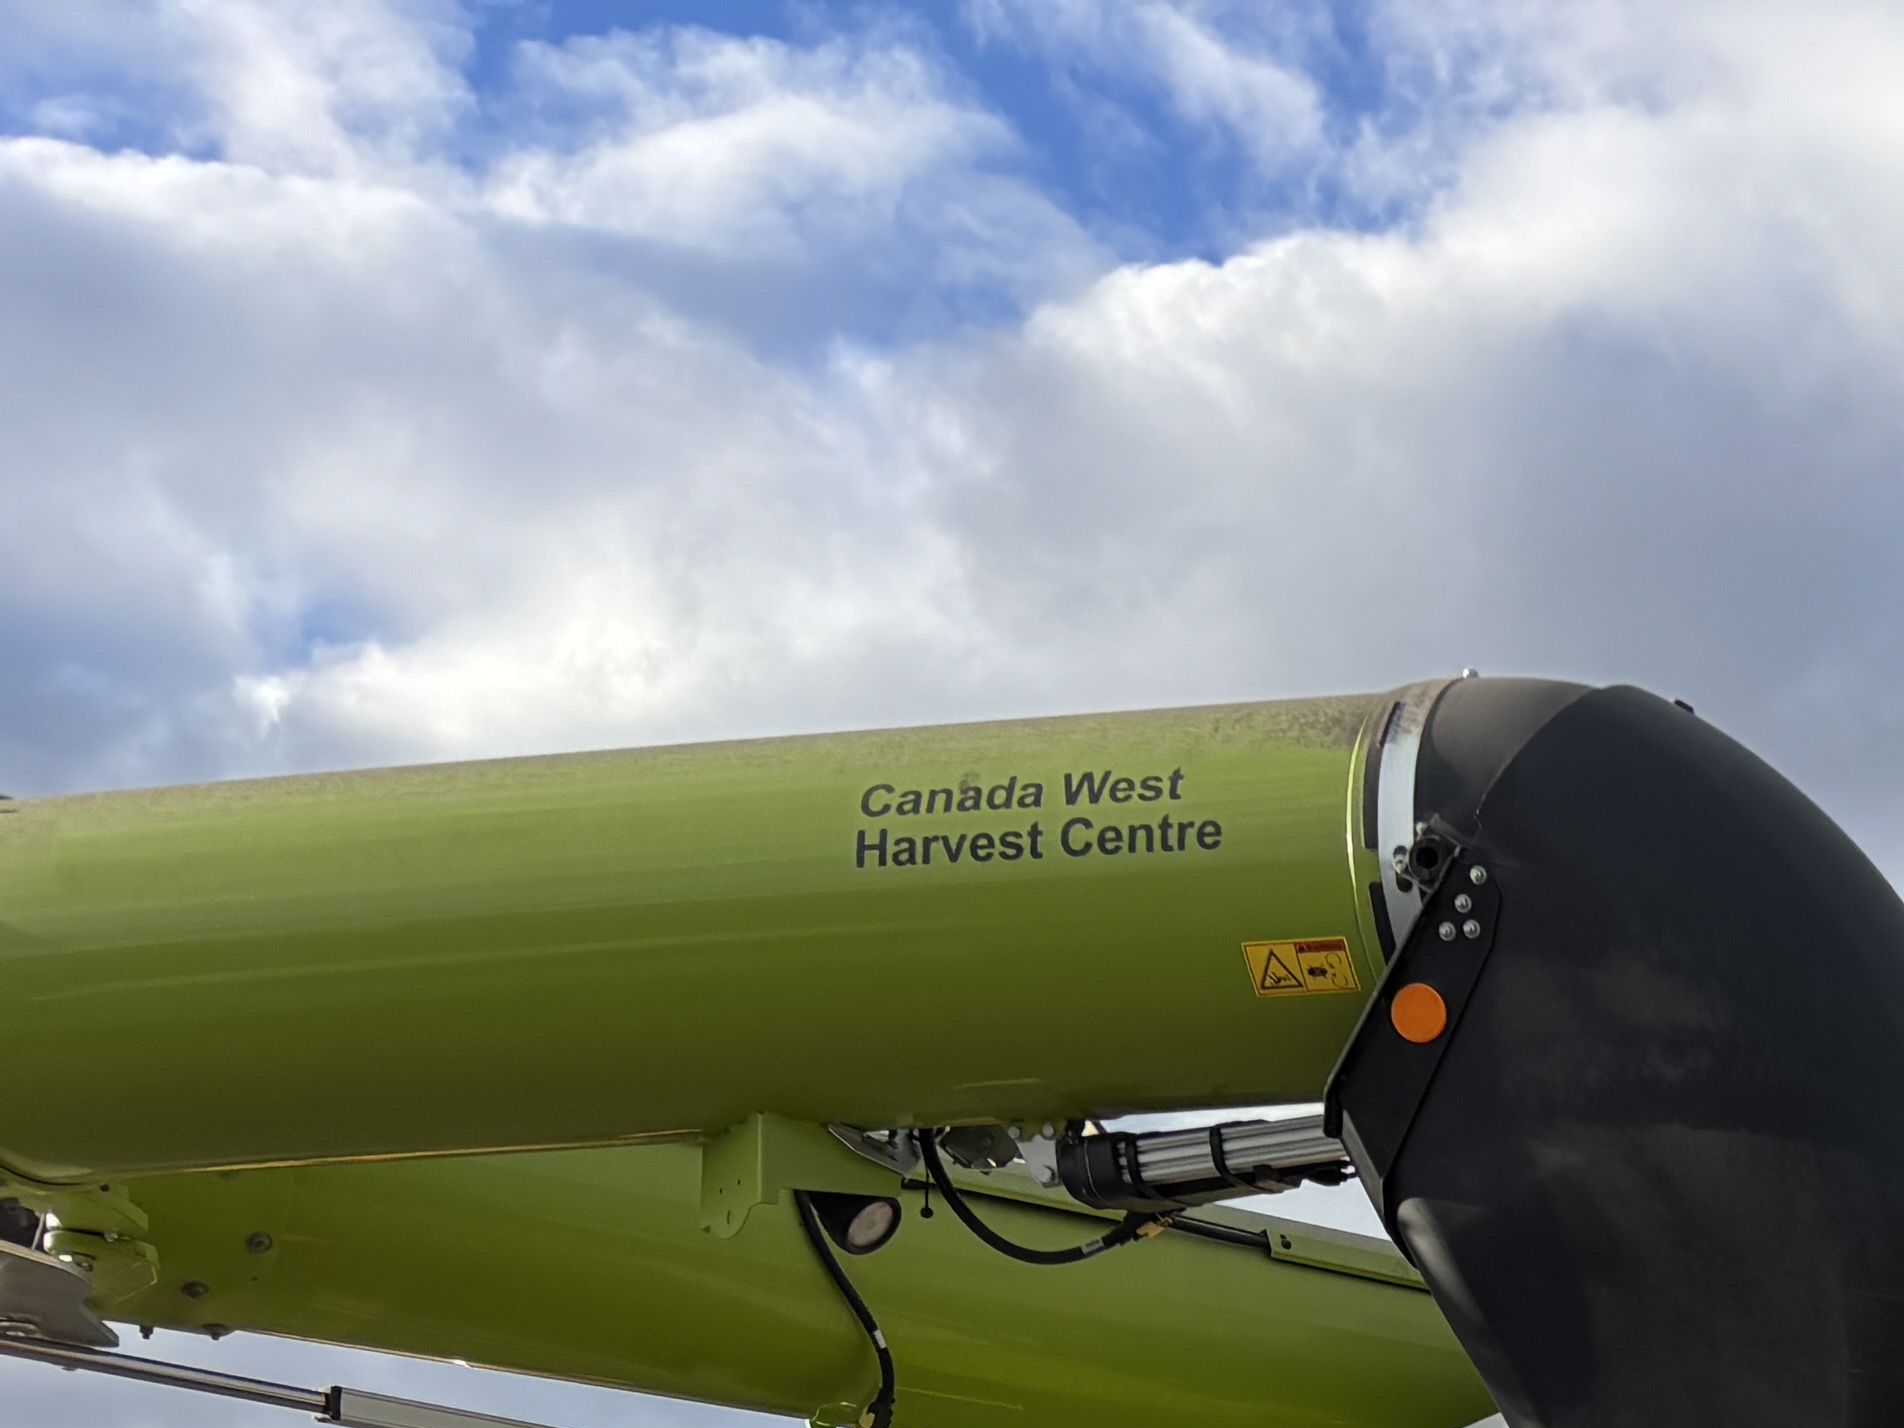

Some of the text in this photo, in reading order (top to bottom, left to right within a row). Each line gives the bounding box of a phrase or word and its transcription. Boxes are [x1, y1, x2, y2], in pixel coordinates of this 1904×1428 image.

[860, 767, 1185, 818] Canada West
[856, 813, 1223, 869] Harvest Centre
